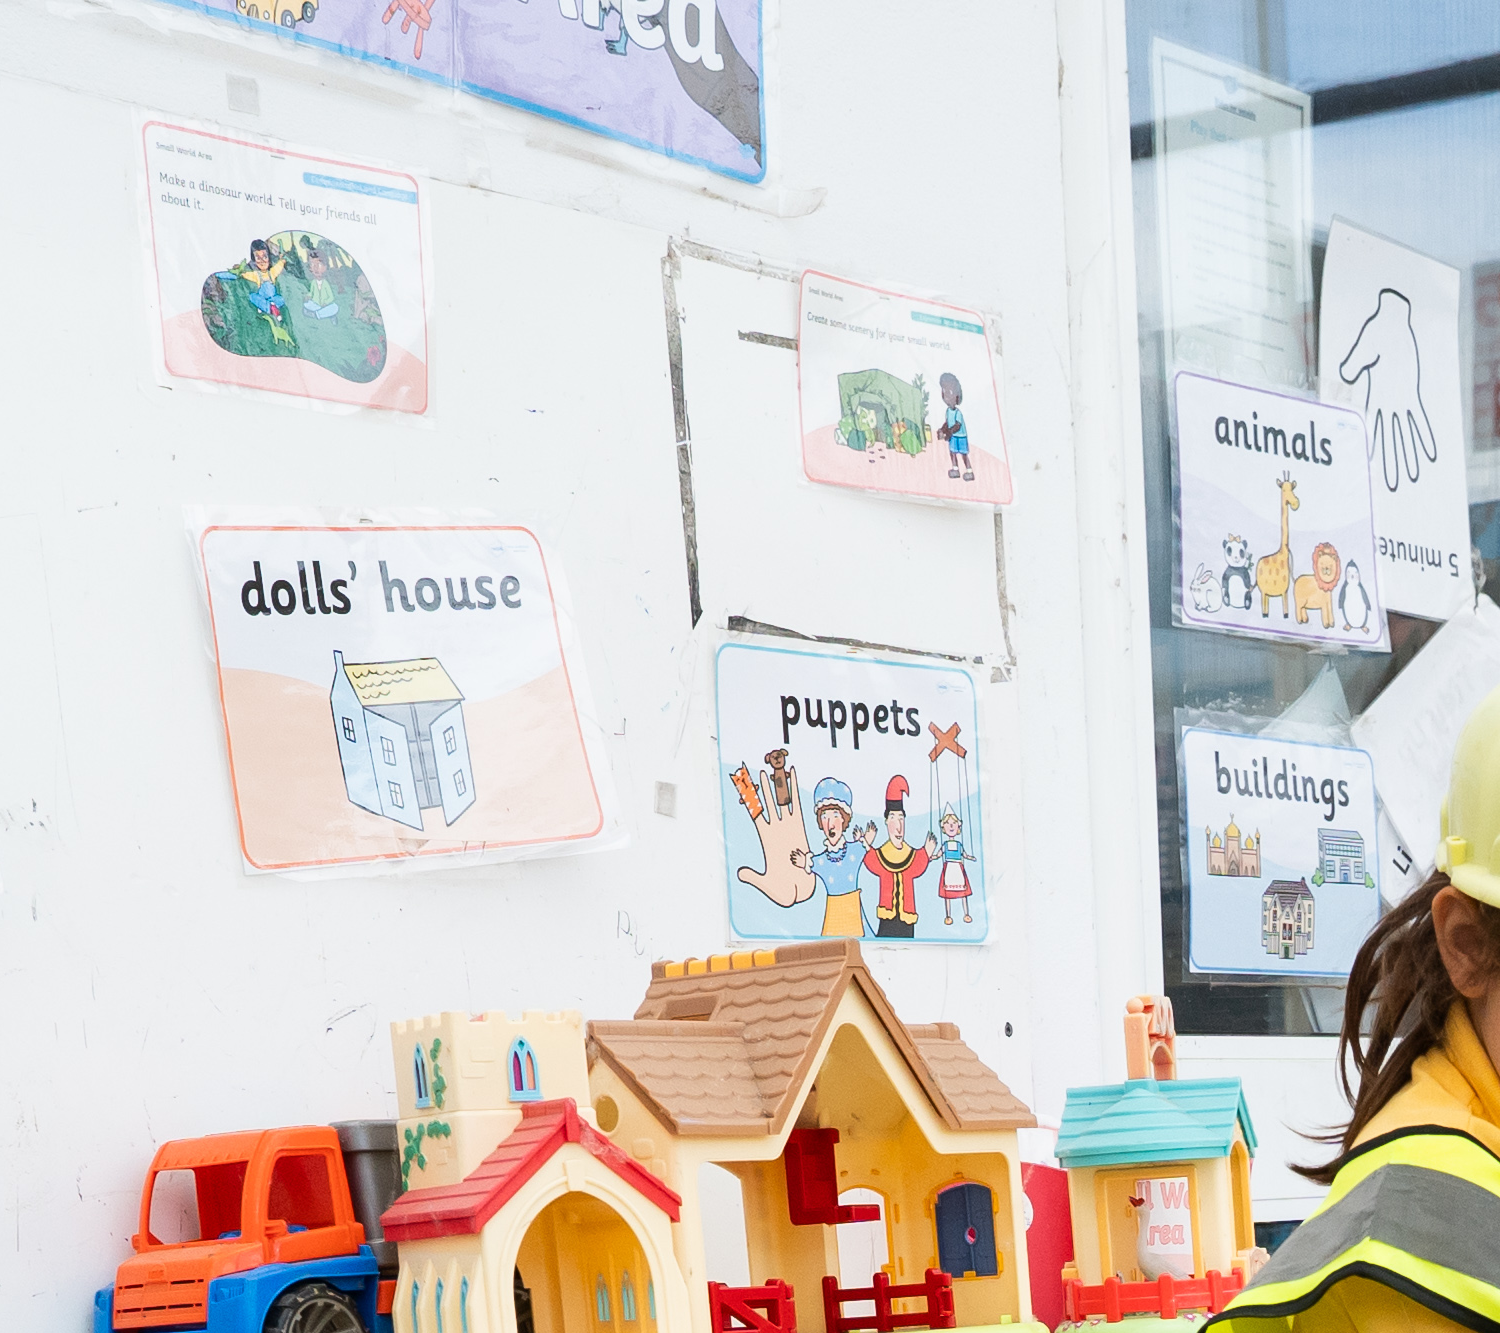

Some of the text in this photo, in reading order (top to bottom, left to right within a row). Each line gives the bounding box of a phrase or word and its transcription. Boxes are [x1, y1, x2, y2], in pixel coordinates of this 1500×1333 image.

[159, 172, 377, 226] Make a dinosaur world. Tell your friends all
[161, 192, 205, 211] about it.
[807, 311, 828, 326] Create
[829, 319, 847, 330] some
[848, 324, 874, 339] scenery
[875, 327, 886, 340] for
[888, 333, 905, 344] your
[907, 336, 927, 347] small
[1214, 411, 1334, 466] animals
[1375, 536, 1459, 578] 5 minute
[378, 560, 522, 613] house
[780, 694, 921, 750] puppets
[1214, 751, 1350, 822] buildings
[1146, 1225, 1185, 1246] rea
